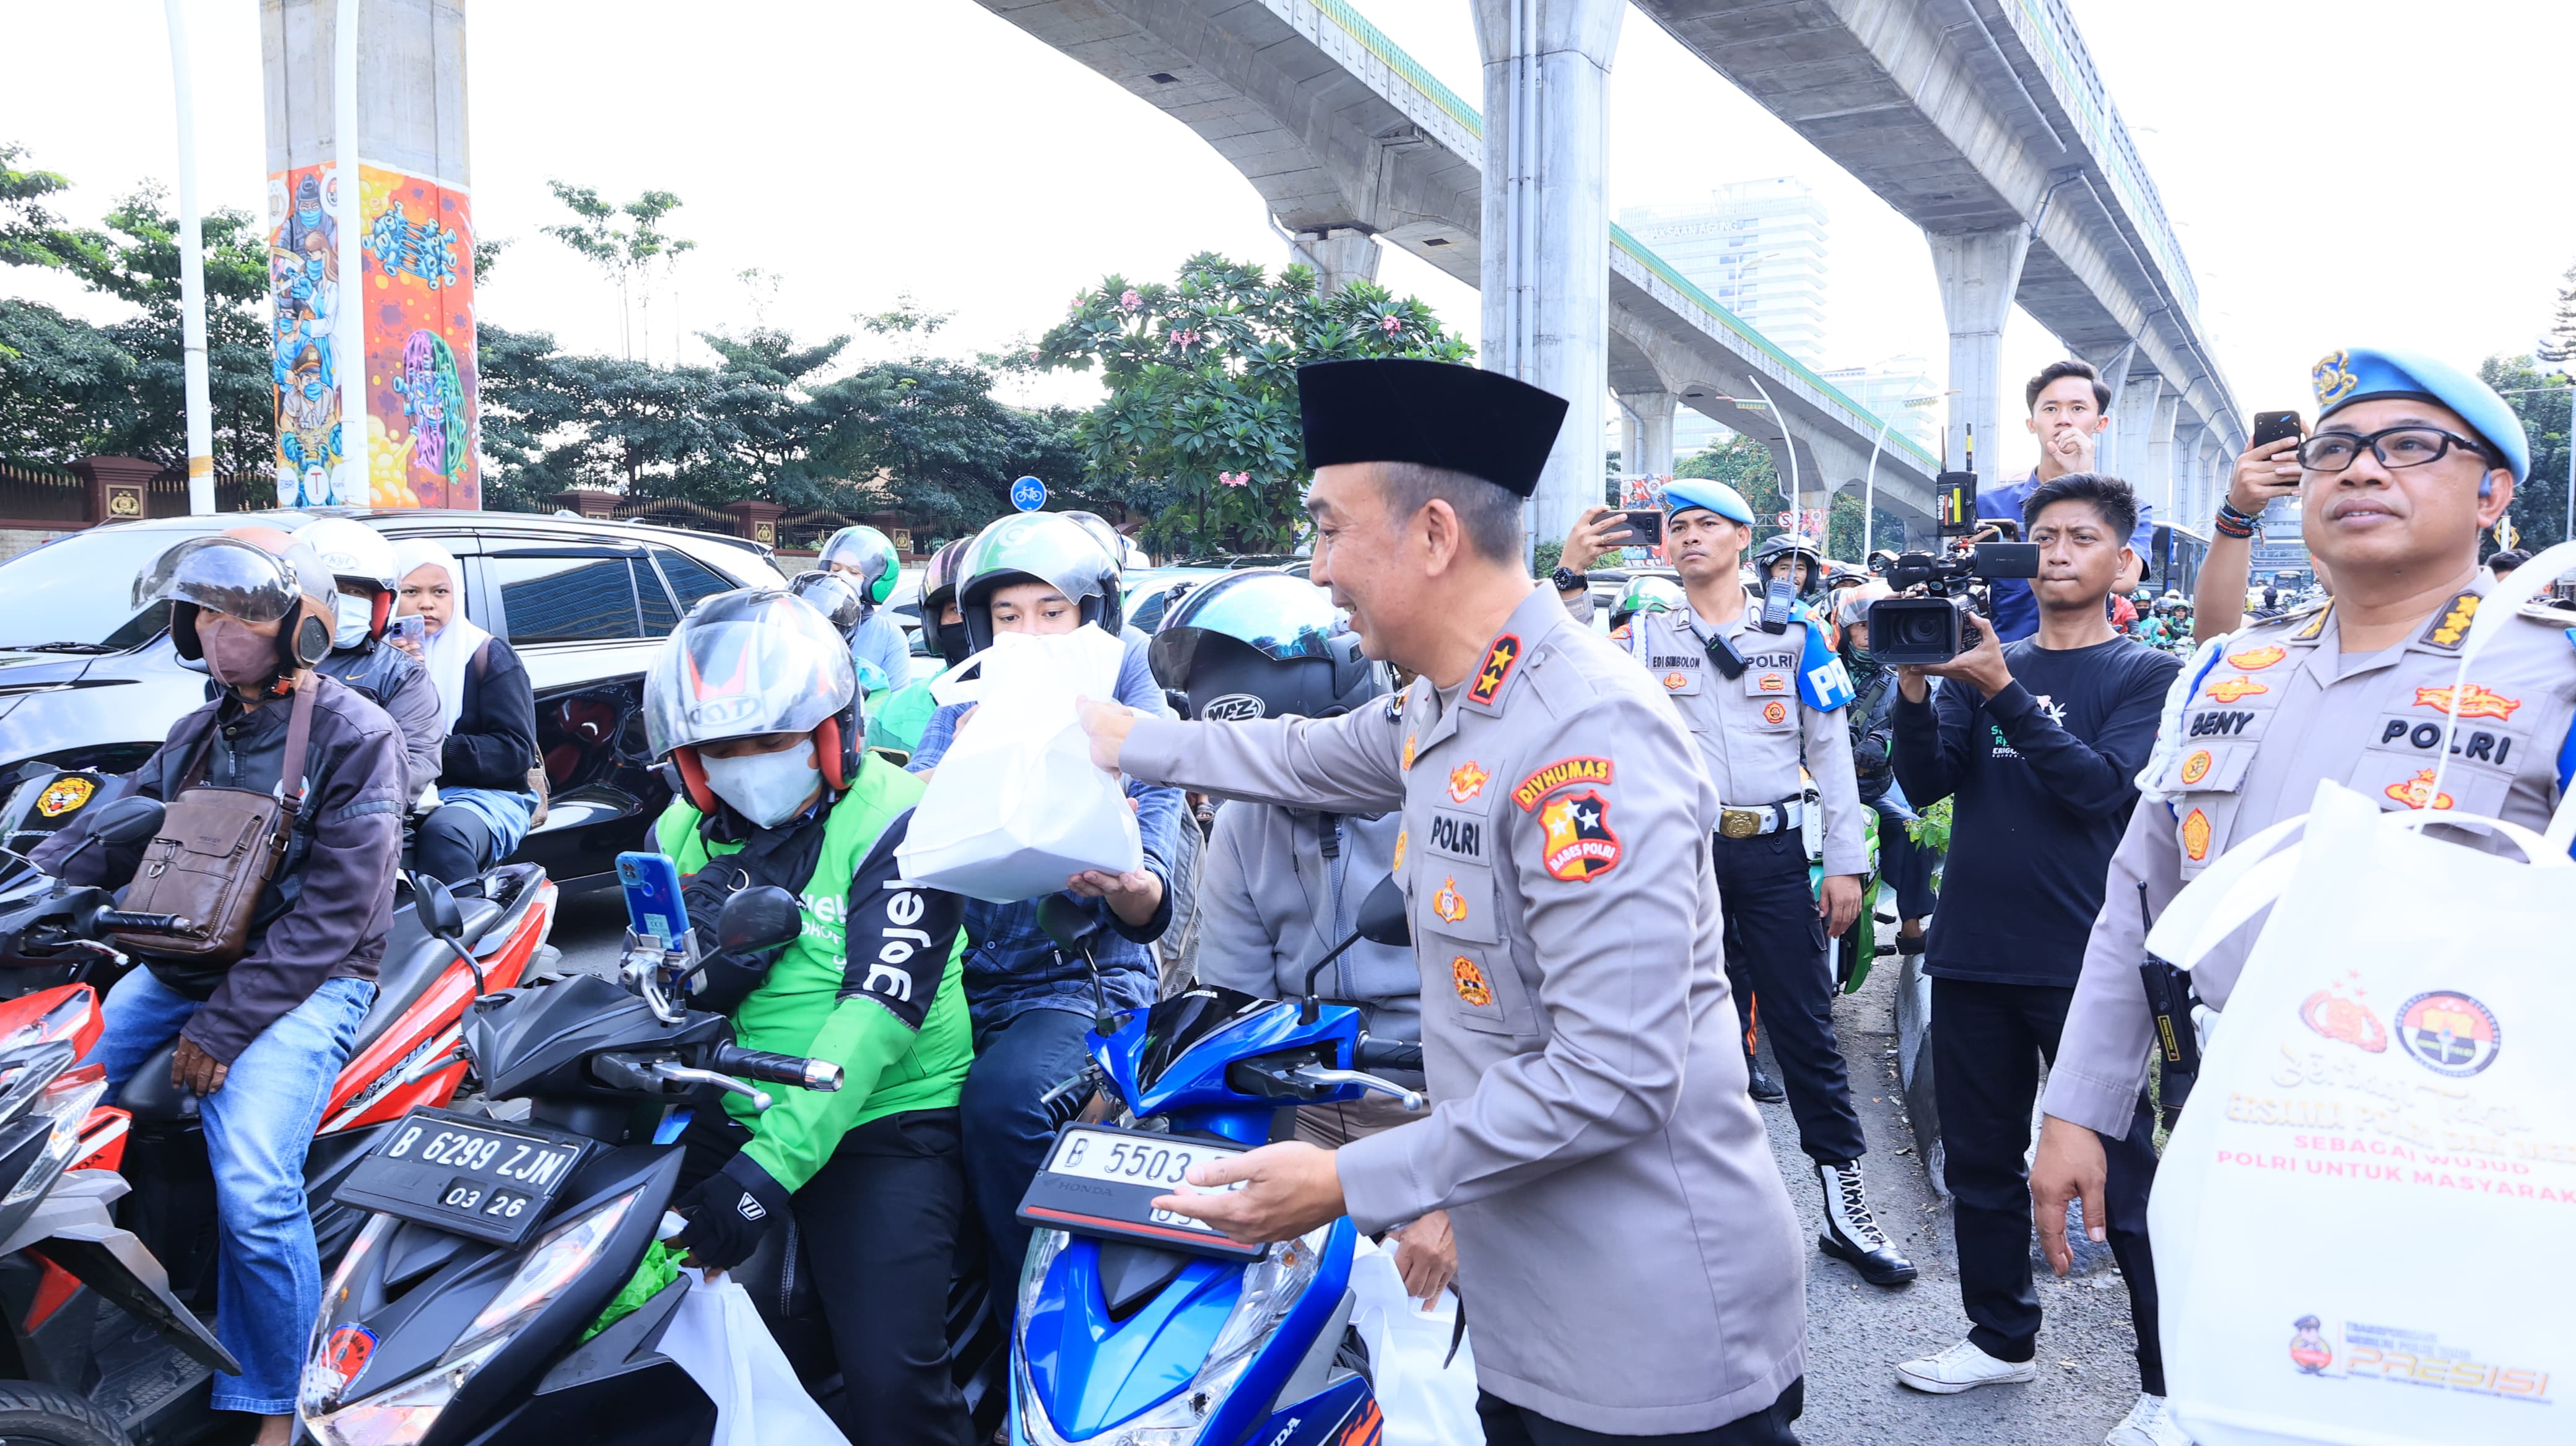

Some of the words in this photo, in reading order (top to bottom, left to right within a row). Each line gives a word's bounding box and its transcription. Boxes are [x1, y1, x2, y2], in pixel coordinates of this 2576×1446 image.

[1653, 656, 1664, 668] EDI
[1744, 655, 1793, 668] POLRI
[2190, 711, 2255, 737] BENY
[1518, 760, 1608, 804] DIVHUMAS
[1430, 816, 1479, 856] POLRI
[1583, 842, 1616, 859] POLRI
[388, 1126, 422, 1158] B
[422, 1131, 502, 1171] 6299
[496, 1145, 566, 1185] ZJN
[1064, 1138, 1089, 1168] B
[1103, 1143, 1191, 1183] 5503
[2217, 1150, 2296, 1172] POLRI
[2305, 1158, 2403, 1183] UNTUK
[2294, 1134, 2416, 1162] SEBAGAI
[2424, 1153, 2530, 1175] WUJUD
[445, 1187, 481, 1208] 03
[486, 1195, 526, 1218] 26
[1058, 1181, 1113, 1196] HONDA
[2347, 1346, 2550, 1398] PRESISI
